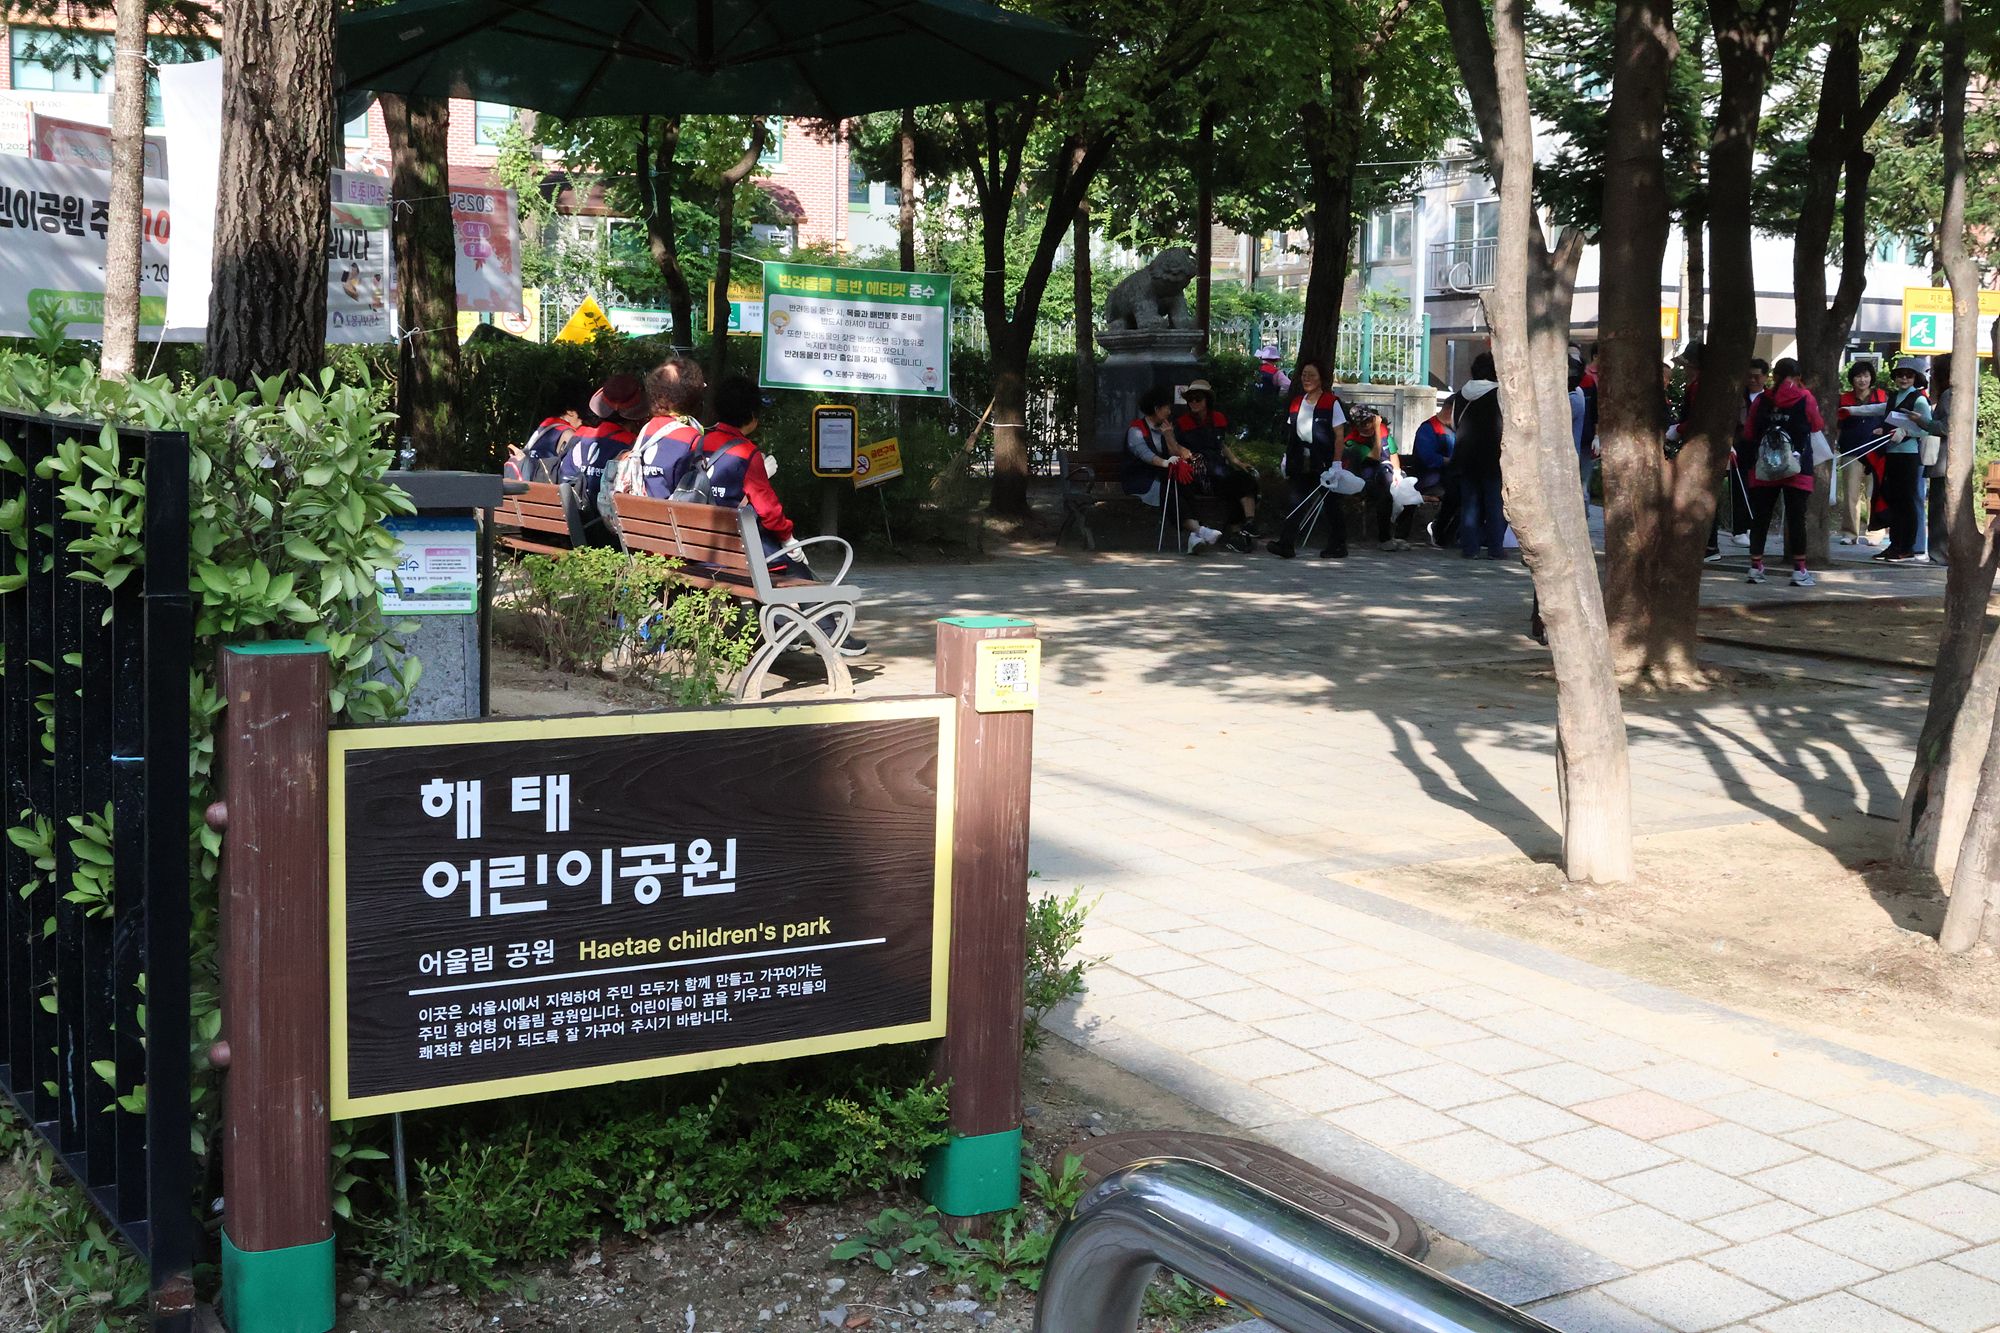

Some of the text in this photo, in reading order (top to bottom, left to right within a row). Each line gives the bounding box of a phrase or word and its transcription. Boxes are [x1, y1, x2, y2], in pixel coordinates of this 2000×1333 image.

[778, 274, 935, 299] 반려동물 동반 에티켓 준수
[1930, 294, 1944, 304] 지진
[789, 304, 817, 314] 반려동물
[820, 306, 834, 315] 동반
[847, 309, 868, 318] 목줄과
[870, 310, 898, 320] 배변봉투
[901, 312, 922, 321] 준비를
[821, 318, 892, 330] 반드시 하셔야 합니다.
[787, 330, 802, 338] 또한
[804, 331, 840, 341] 반려동물의
[842, 334, 856, 342] 잦은
[902, 338, 924, 347] 행위로
[784, 350, 821, 360] 반려동물의
[840, 354, 860, 362] 출입을
[863, 356, 878, 364] 자제
[880, 357, 924, 367] 부탁드립니다.
[829, 344, 850, 352] 훼손이
[883, 347, 906, 356] 있으니,
[835, 370, 888, 380] 도봉구 공원여가과
[871, 444, 896, 459] 금연구역
[422, 837, 737, 918] 어린이공원
[579, 916, 832, 961] Haetae children's park
[418, 939, 555, 977] 어울림 공원
[418, 963, 823, 1023] 이곳은 서울시에서 지원하여 주민 모두가 함께 만들고 가꾸어가는
[418, 978, 827, 1042] 주민 참여형 어울림 공원입니다. 어린이들이 꿈을 키우고 주민들의
[418, 1008, 733, 1060] 쾌적한 쉼터가 되도록 잘 가꾸어 주시기 바랍니다.
